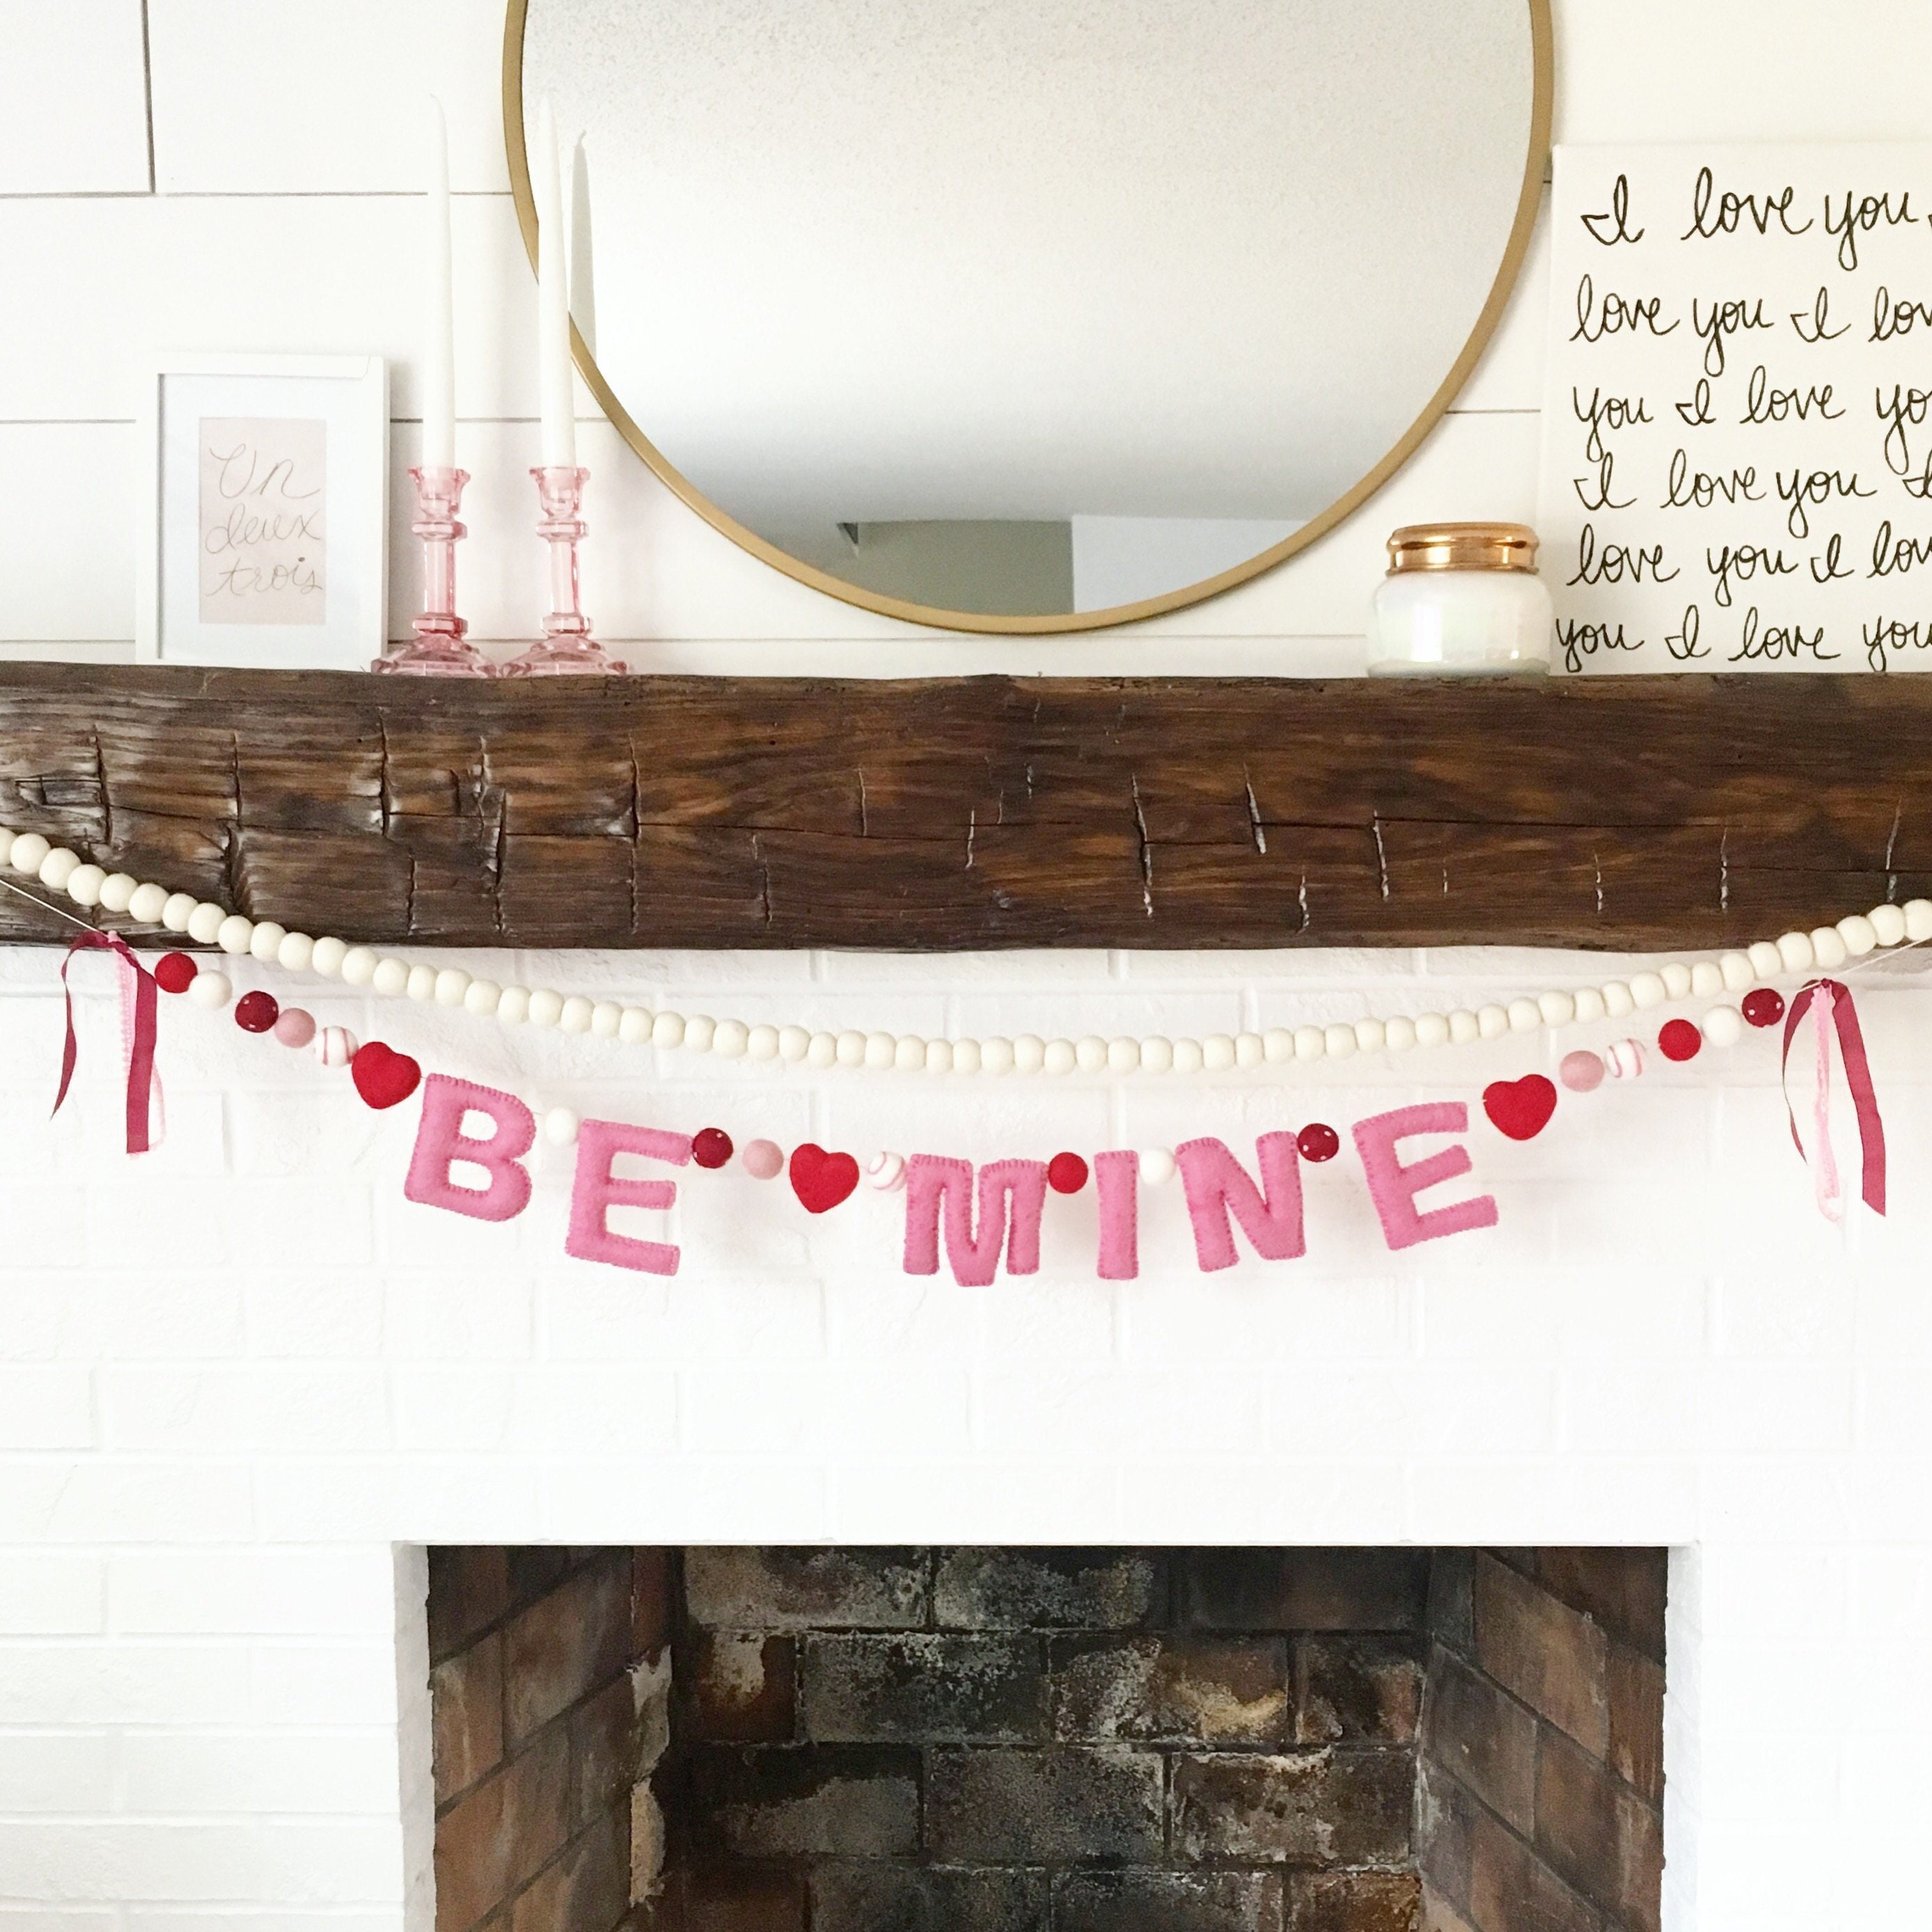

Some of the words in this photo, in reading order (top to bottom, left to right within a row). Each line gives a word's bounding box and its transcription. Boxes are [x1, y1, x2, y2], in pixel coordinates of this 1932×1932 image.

[1580, 174, 1644, 246] I
[1681, 167, 1813, 240] love
[1825, 191, 1918, 271] you
[1569, 274, 1680, 342] love
[1693, 299, 1774, 377] you
[1791, 287, 1851, 343] I
[1869, 287, 1932, 342] lov
[1573, 387, 1653, 462] you
[1676, 379, 1716, 425] I
[1740, 366, 1845, 423] love
[1876, 384, 1932, 475] yo
[210, 443, 321, 499] Un
[1573, 452, 1637, 510] I
[1660, 449, 1766, 508] love
[1776, 469, 1877, 538] you
[205, 503, 320, 555] deux
[1566, 524, 1680, 586] love
[1707, 545, 1798, 606] you
[1811, 534, 1854, 583] I
[1867, 521, 1932, 578] lov
[205, 557, 323, 597] trois
[1555, 618, 1644, 672] you
[1665, 605, 1711, 659] I
[1728, 607, 1841, 661] love
[405, 1072, 693, 1276] BE
[902, 1101, 1499, 1287] MINE
